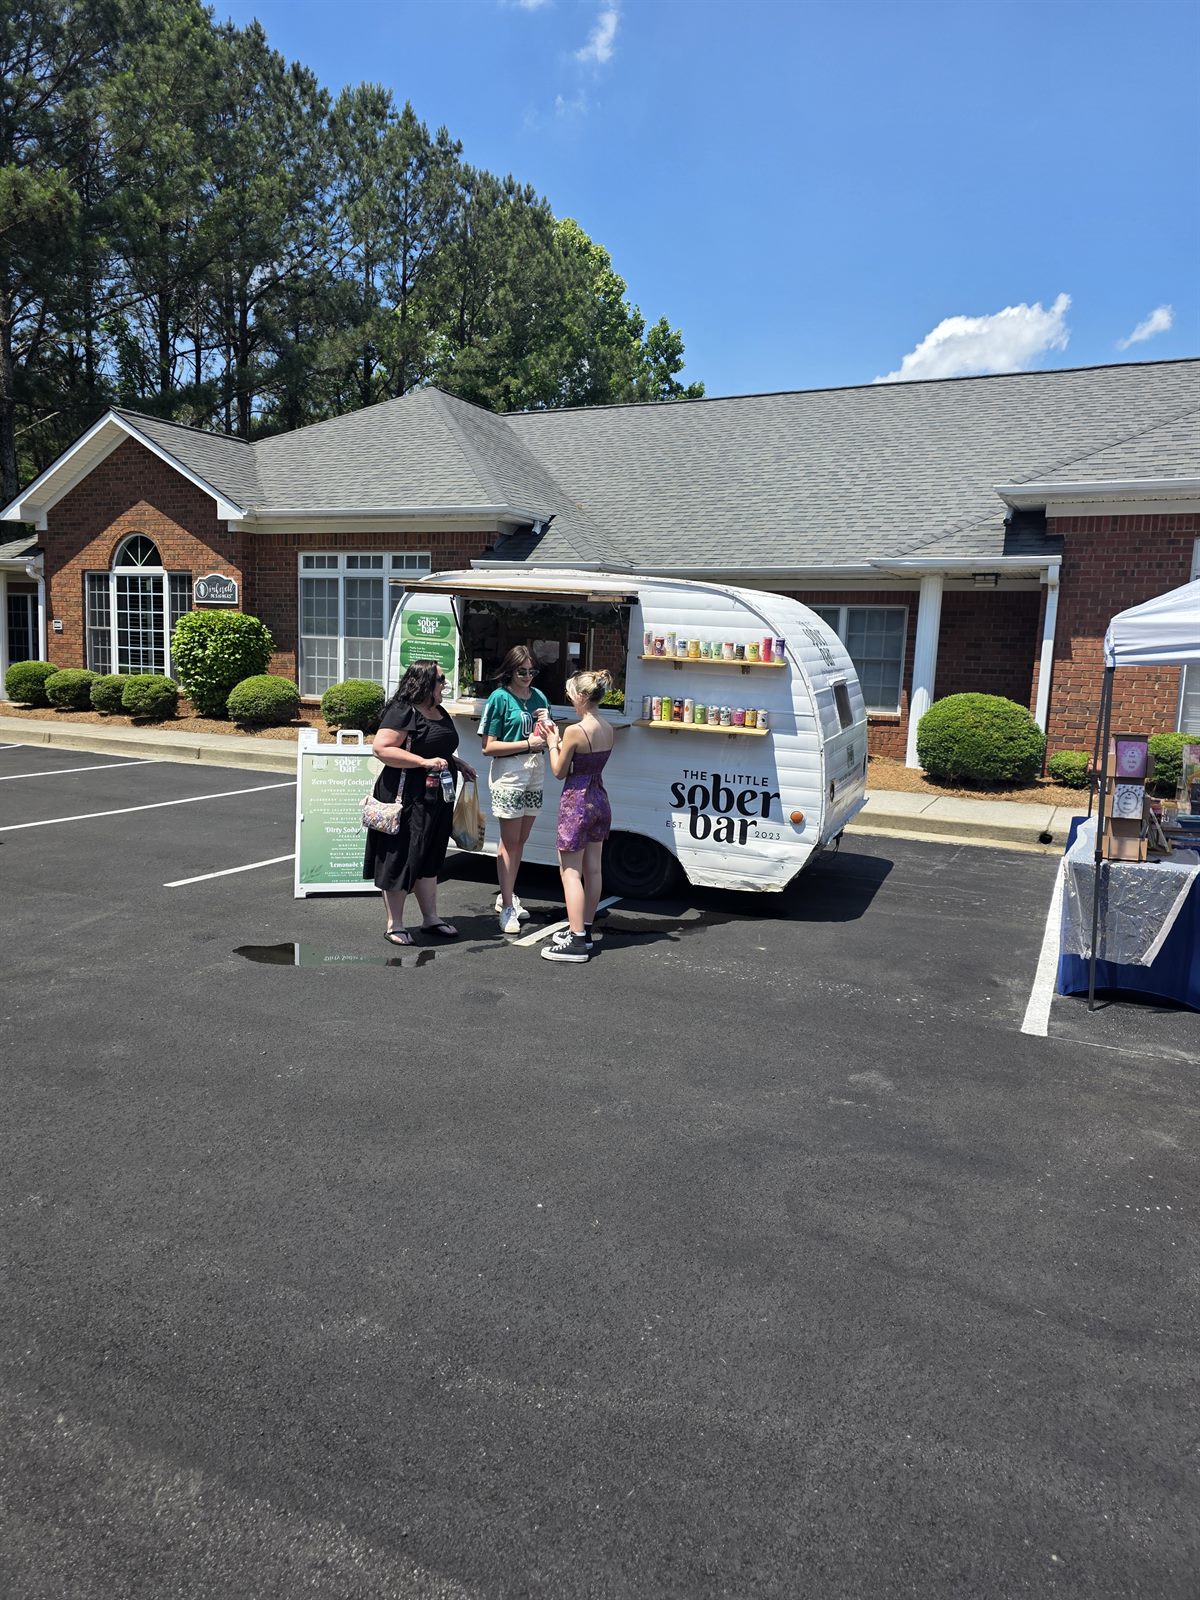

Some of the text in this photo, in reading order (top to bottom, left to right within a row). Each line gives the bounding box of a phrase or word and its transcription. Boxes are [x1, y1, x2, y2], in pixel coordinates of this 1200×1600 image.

[417, 617, 440, 628] sober
[421, 624, 436, 634] bar
[334, 757, 362, 767] sober
[339, 763, 358, 773] bar
[347, 778, 374, 786] Cocktail
[683, 770, 769, 787] THE LITTLE
[668, 773, 781, 819] sober
[687, 805, 758, 846] bar
[754, 831, 781, 841] 2023
